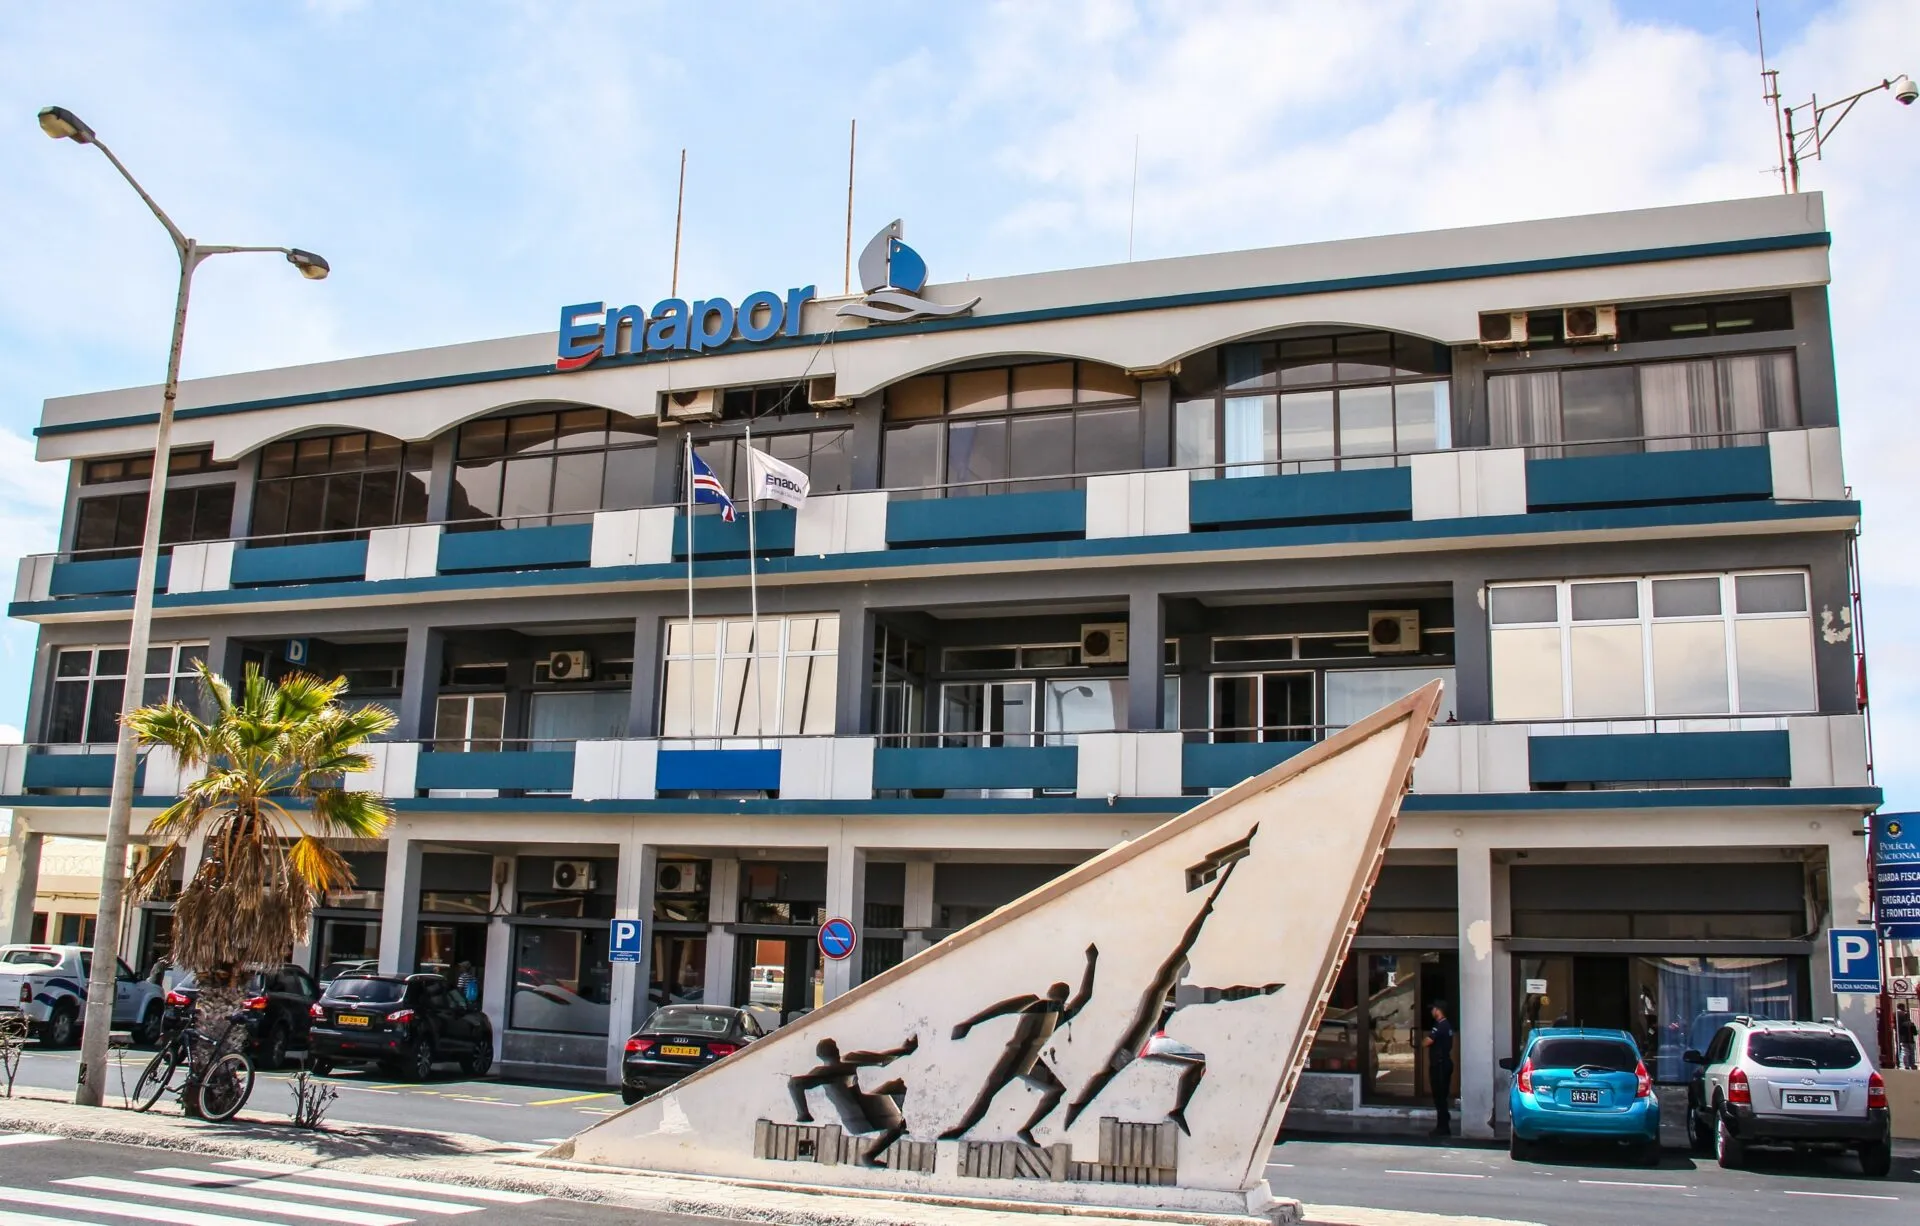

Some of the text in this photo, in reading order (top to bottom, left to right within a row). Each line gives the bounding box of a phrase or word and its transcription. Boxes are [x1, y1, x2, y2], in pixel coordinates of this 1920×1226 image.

[556, 284, 817, 371] Enapor
[289, 639, 304, 660] D
[616, 922, 636, 949] P
[1837, 935, 1870, 974] P
